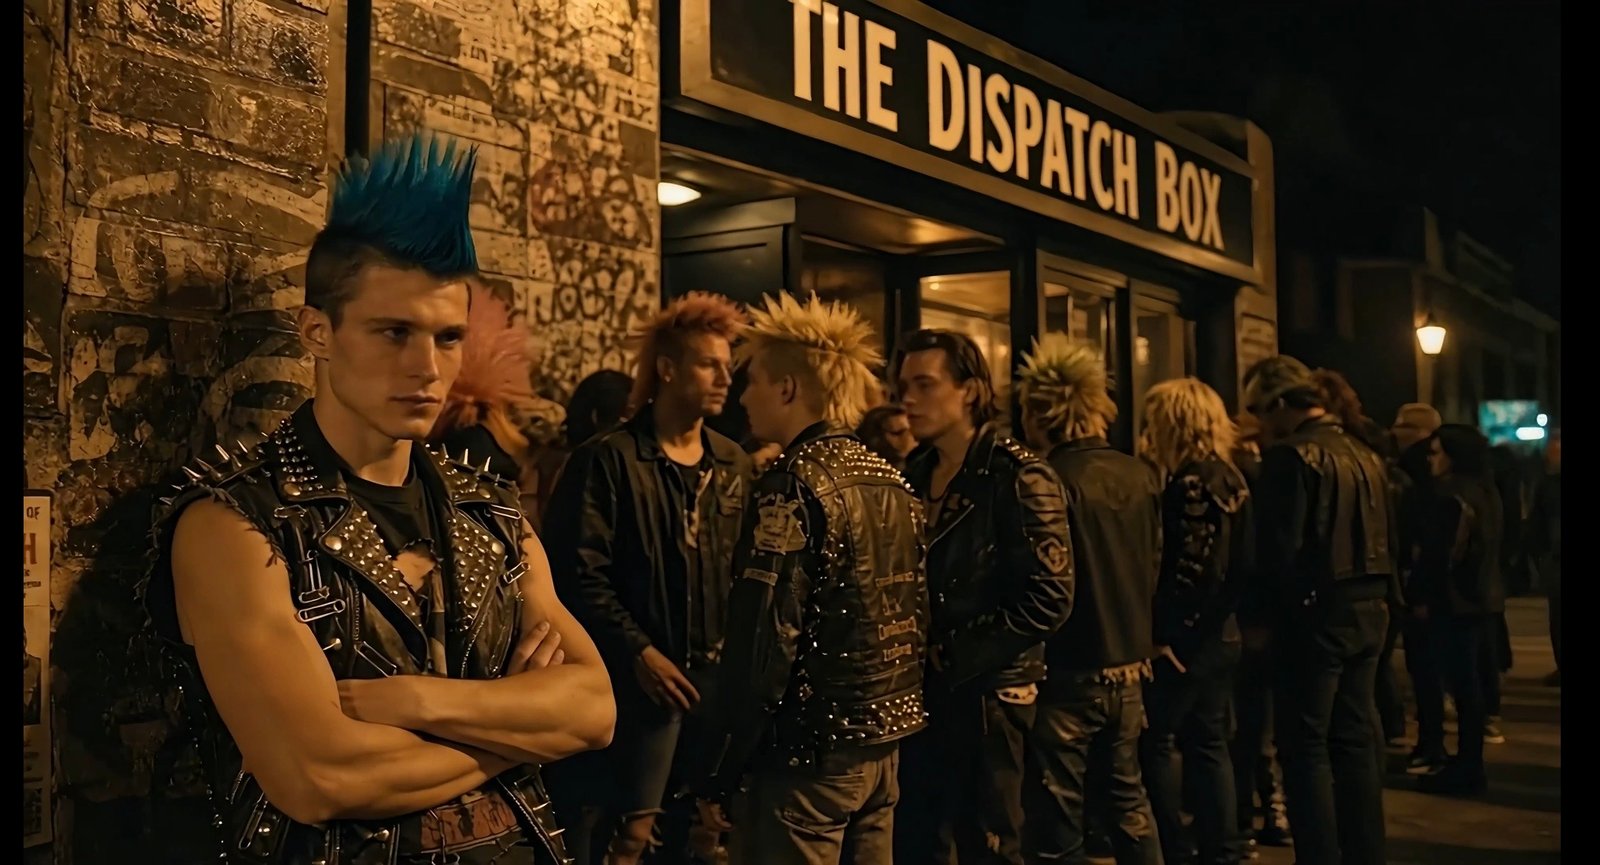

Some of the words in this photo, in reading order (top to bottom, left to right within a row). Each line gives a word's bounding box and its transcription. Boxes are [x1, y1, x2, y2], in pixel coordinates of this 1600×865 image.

[788, 0, 899, 133] THE
[926, 39, 1140, 220] DISPATCH
[1154, 140, 1225, 251] BOX
[26, 506, 41, 520] OF
